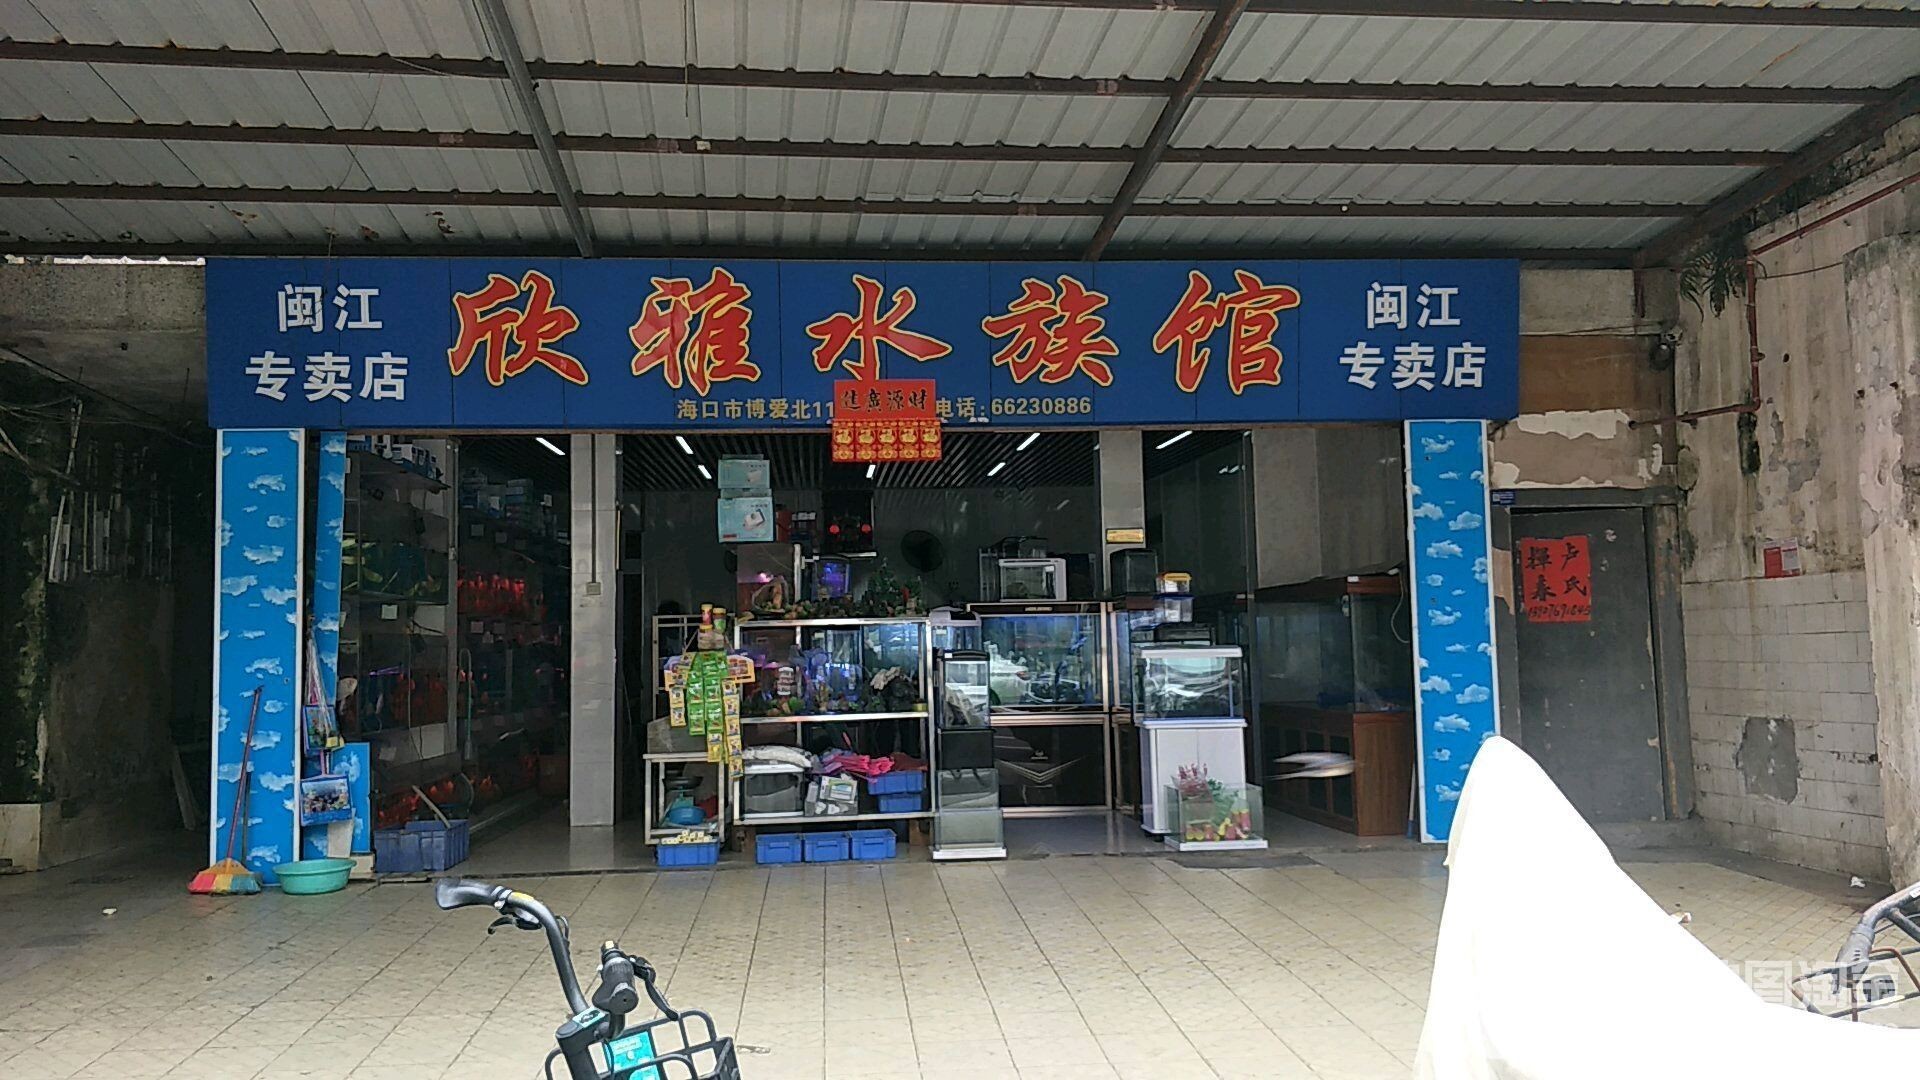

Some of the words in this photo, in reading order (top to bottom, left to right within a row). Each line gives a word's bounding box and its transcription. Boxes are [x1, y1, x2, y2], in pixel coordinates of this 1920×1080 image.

[277, 284, 383, 332] 闽江
[1366, 281, 1461, 330] 闽江
[448, 267, 1300, 396] 欣雅水族馆
[245, 350, 408, 402] 专卖店
[1339, 341, 1487, 392] 专卖店
